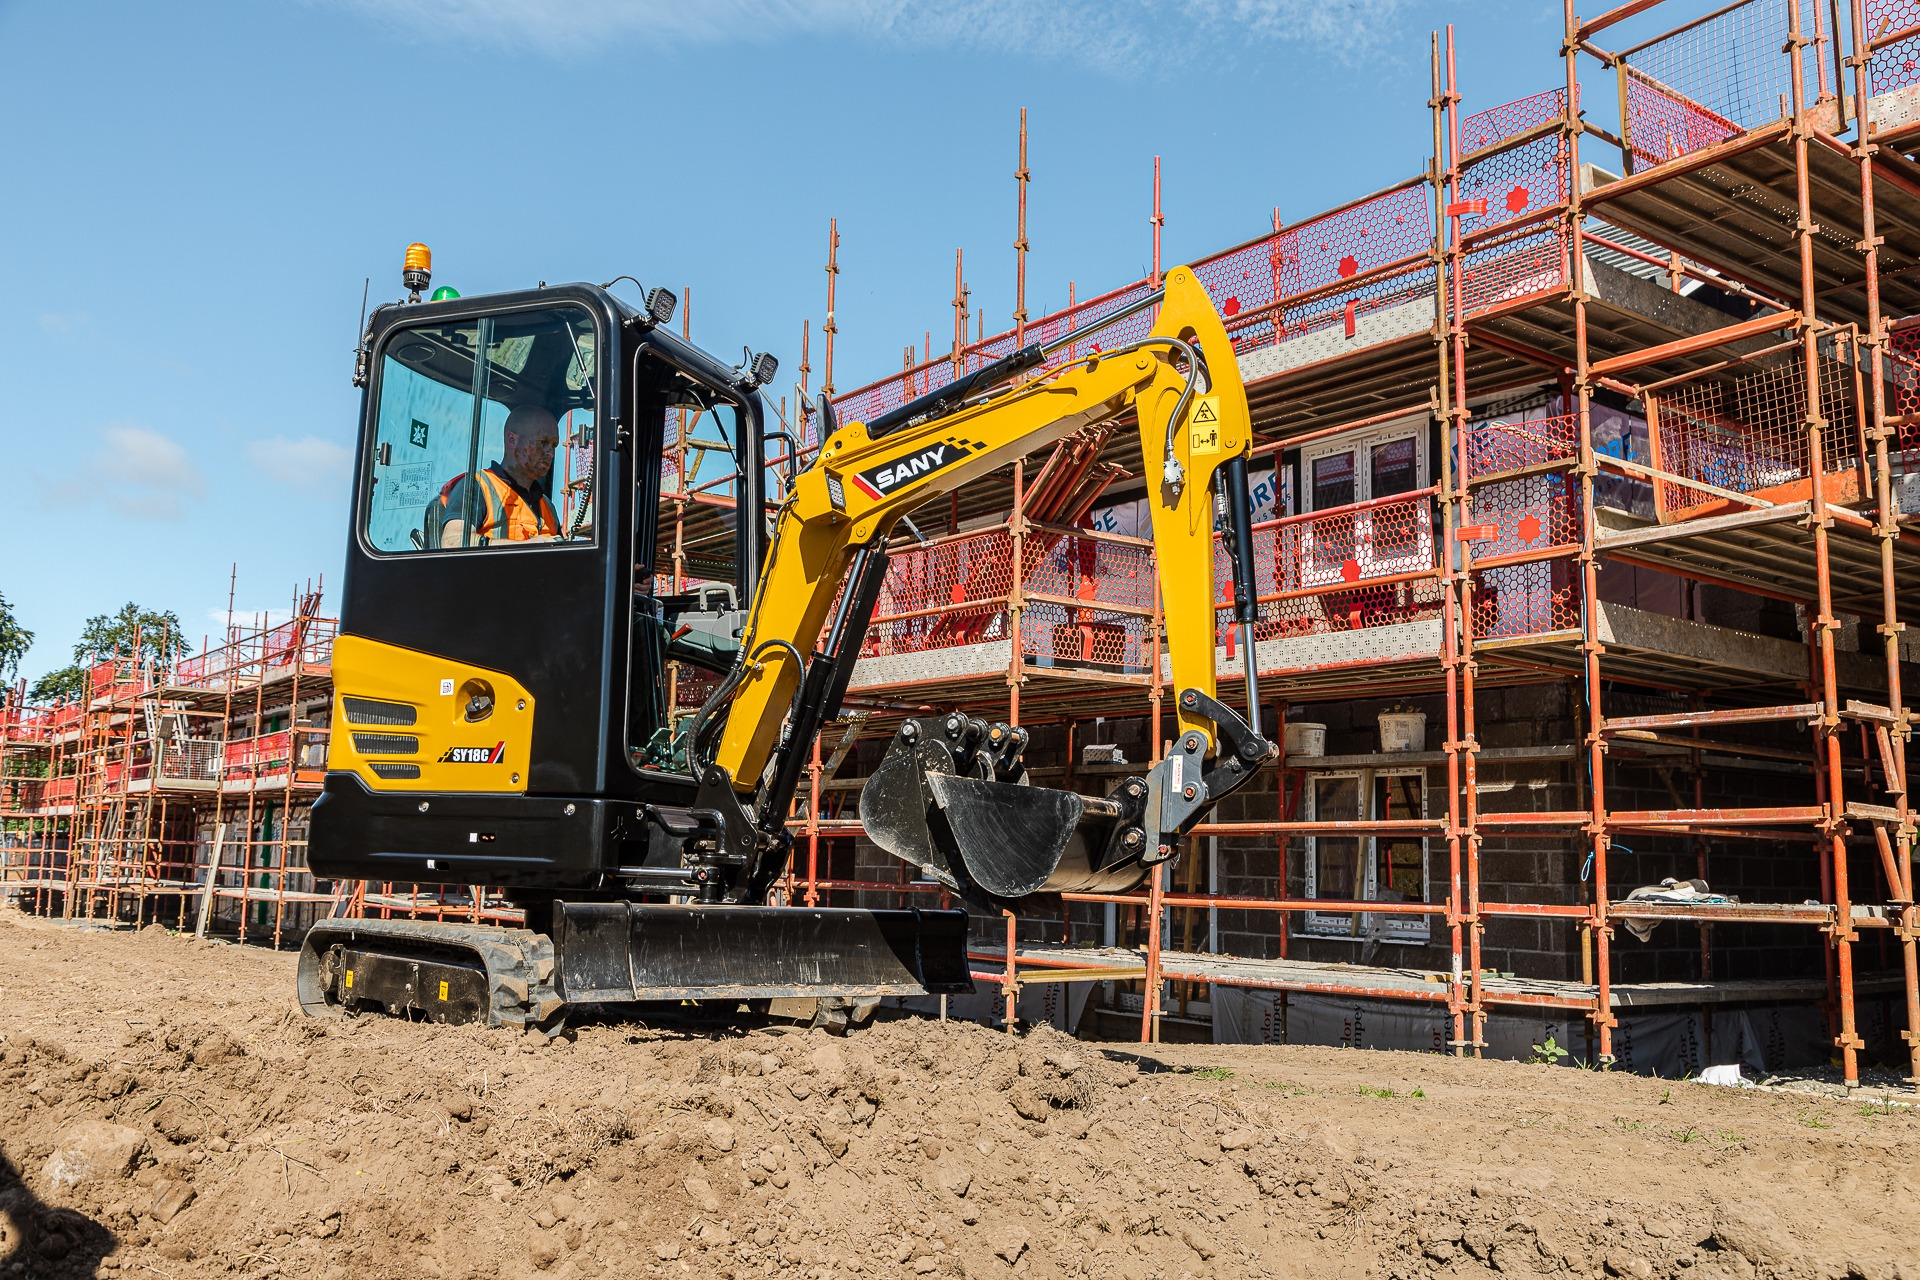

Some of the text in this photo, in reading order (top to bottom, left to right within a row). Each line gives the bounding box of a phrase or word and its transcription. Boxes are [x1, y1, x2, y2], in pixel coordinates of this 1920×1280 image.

[875, 445, 946, 490] SANY
[452, 748, 490, 762] SY18C
[1271, 994, 1282, 1044] impey
[1354, 1004, 1365, 1048] mpey
